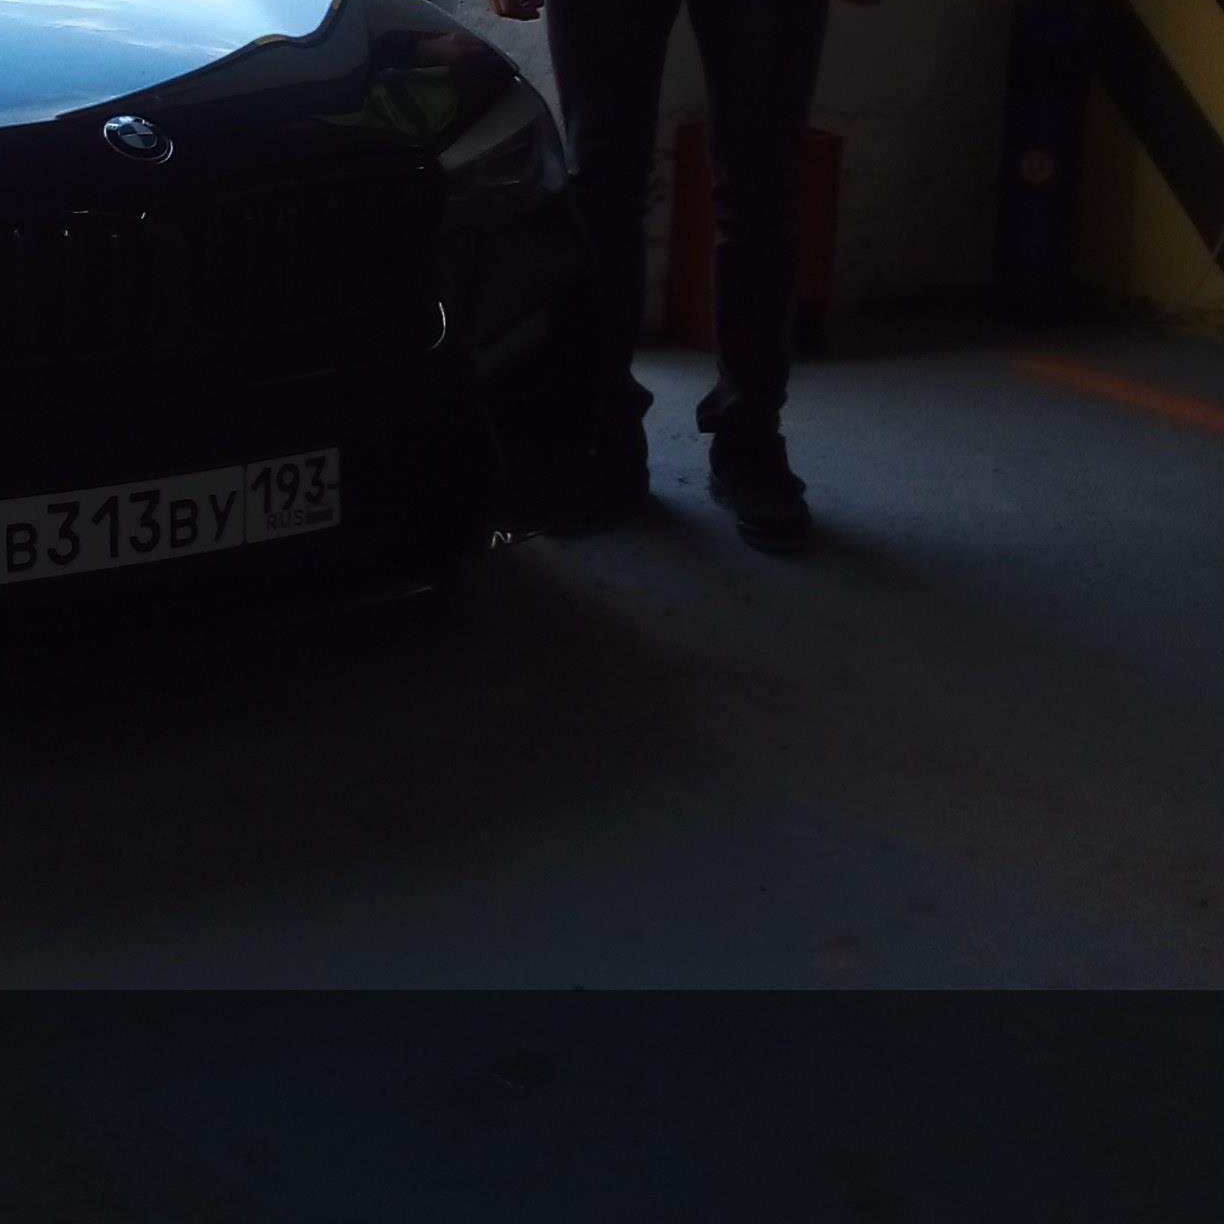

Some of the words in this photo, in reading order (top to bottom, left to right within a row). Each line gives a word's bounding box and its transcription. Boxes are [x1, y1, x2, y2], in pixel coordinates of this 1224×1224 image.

[6, 489, 237, 573] В313ВУ
[251, 455, 327, 514] 193
[266, 508, 305, 532] RUS
